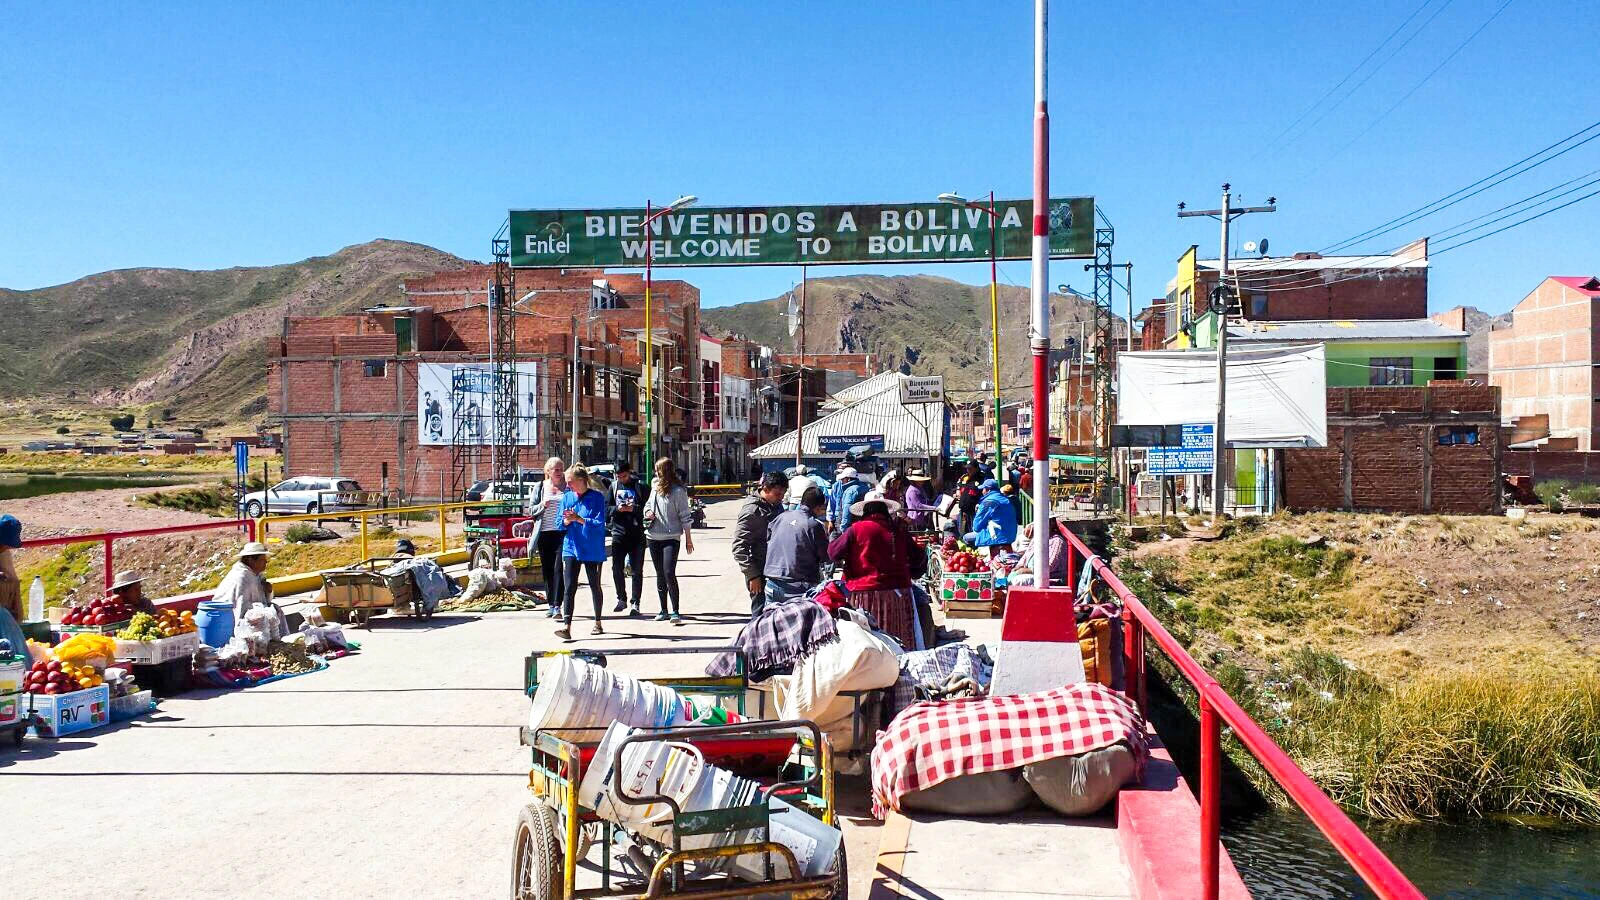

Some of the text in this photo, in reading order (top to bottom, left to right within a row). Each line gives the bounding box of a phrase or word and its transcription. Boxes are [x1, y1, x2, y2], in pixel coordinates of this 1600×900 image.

[585, 206, 1023, 237] BIENVENIDOS A BOLIVIA
[525, 233, 570, 254] Entel
[620, 233, 974, 258] WELCOME TO BOLIVIA
[60, 704, 85, 725] RV
